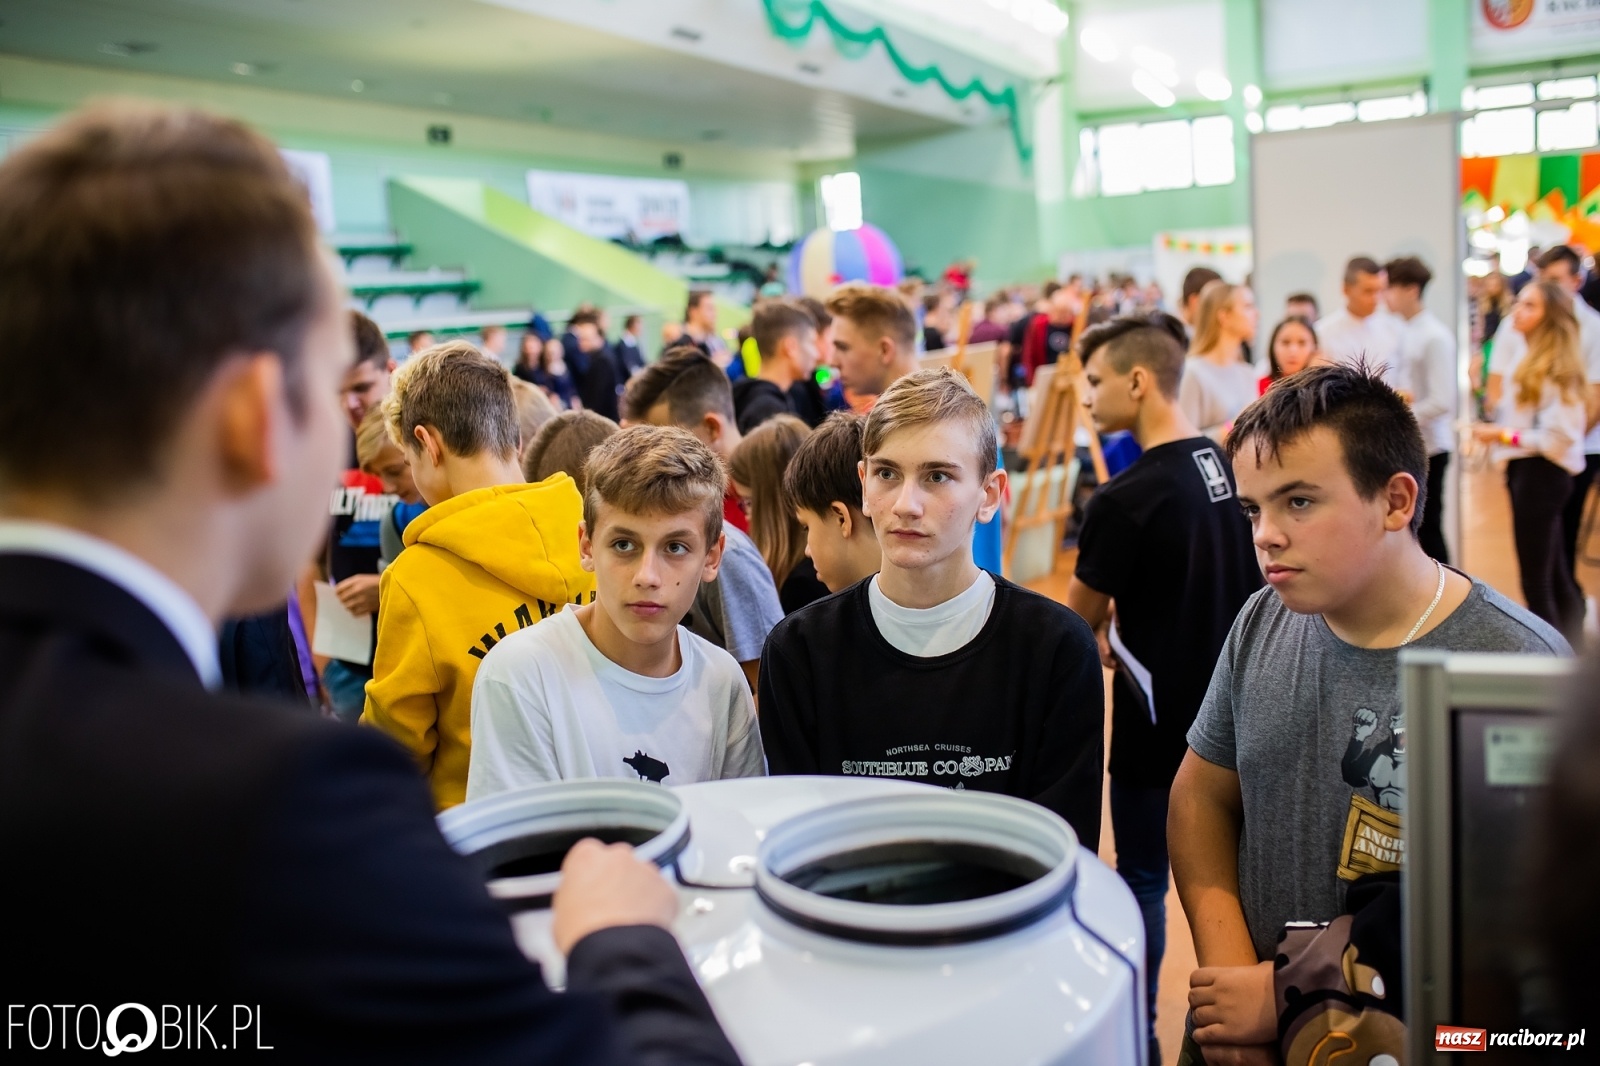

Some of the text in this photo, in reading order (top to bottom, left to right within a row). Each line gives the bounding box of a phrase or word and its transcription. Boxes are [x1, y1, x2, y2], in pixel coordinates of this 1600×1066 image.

[886, 743, 972, 757] NORTHSEA CRUISES
[841, 760, 929, 776] SOUTHBLUE
[1360, 826, 1407, 851] ANGR
[1353, 838, 1408, 864] ANIMA
